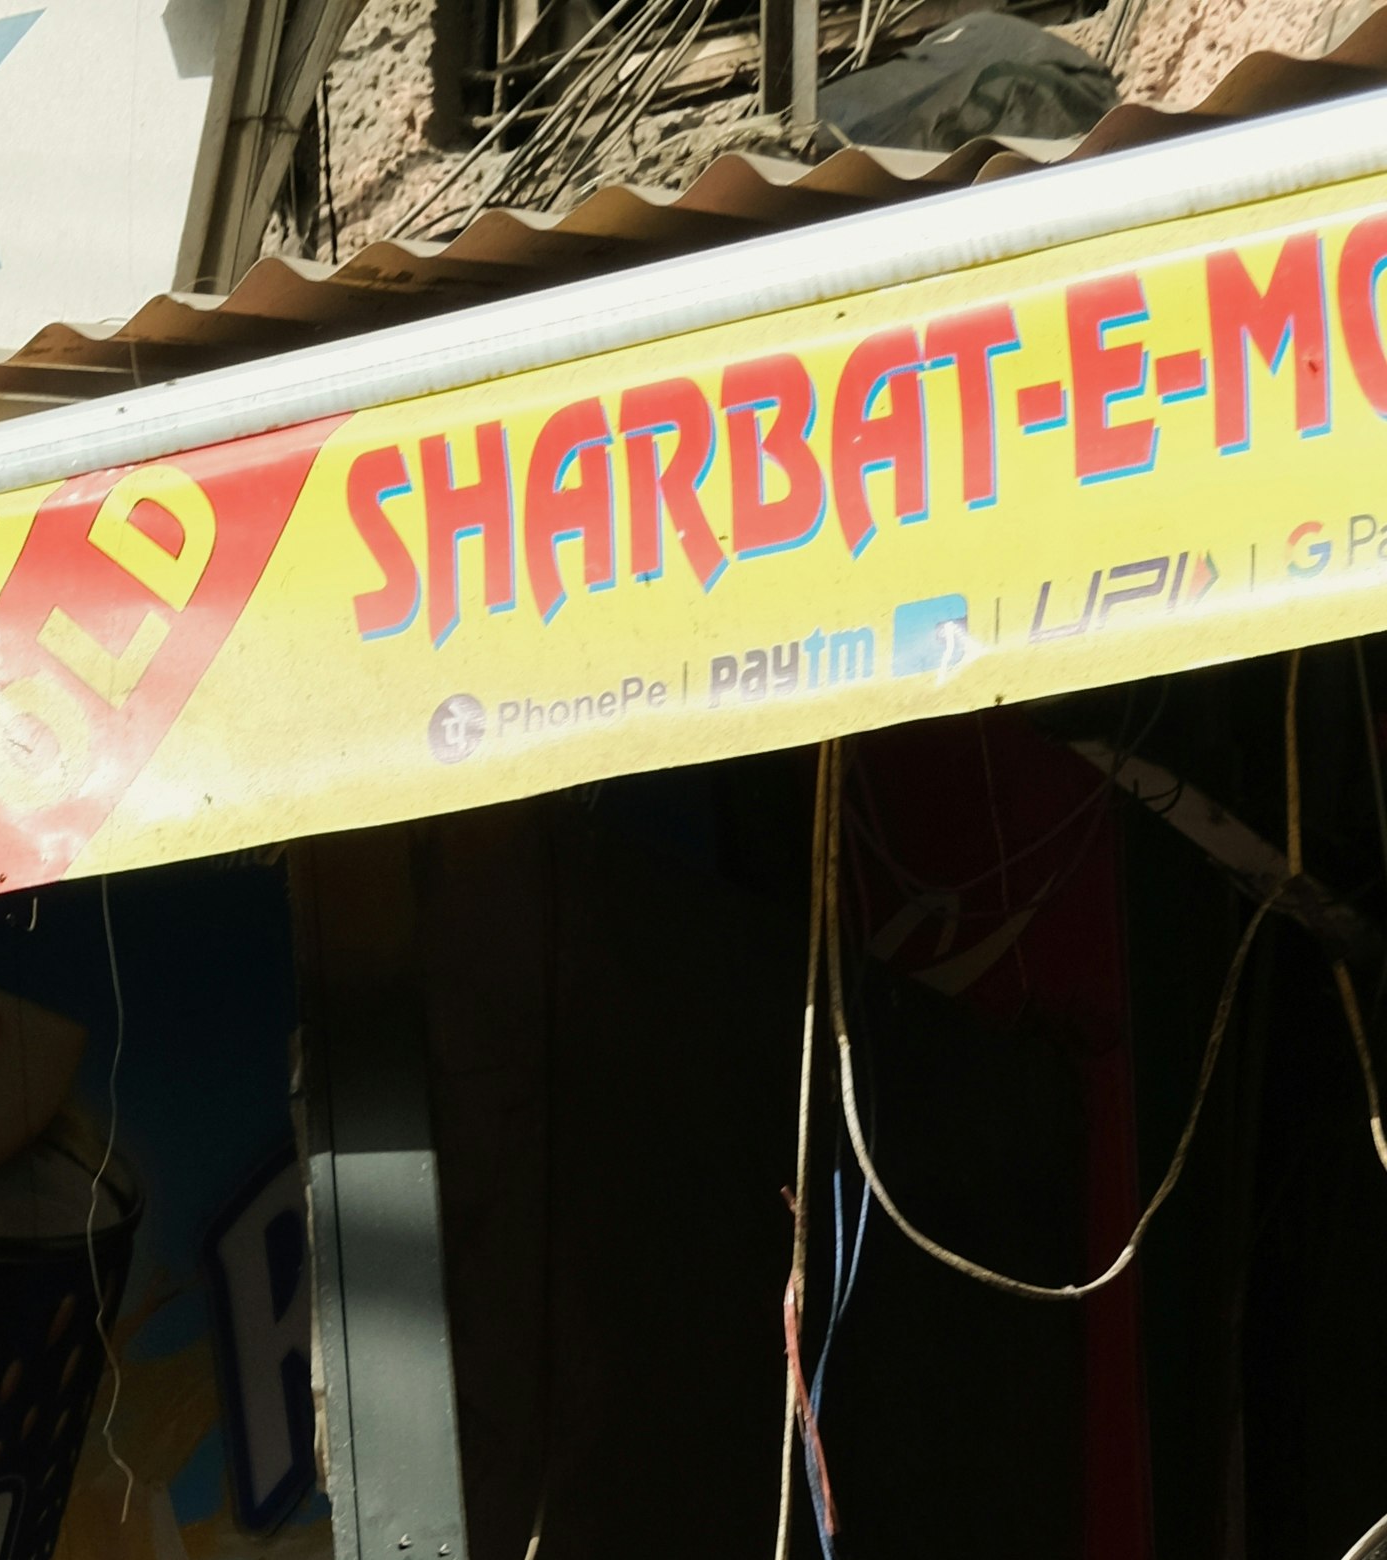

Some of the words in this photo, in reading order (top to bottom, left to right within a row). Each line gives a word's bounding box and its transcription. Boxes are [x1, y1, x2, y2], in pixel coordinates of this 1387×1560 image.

[496, 675, 667, 739] PhonePe
[709, 625, 874, 708] paytm
[1028, 552, 1190, 644] UPI
